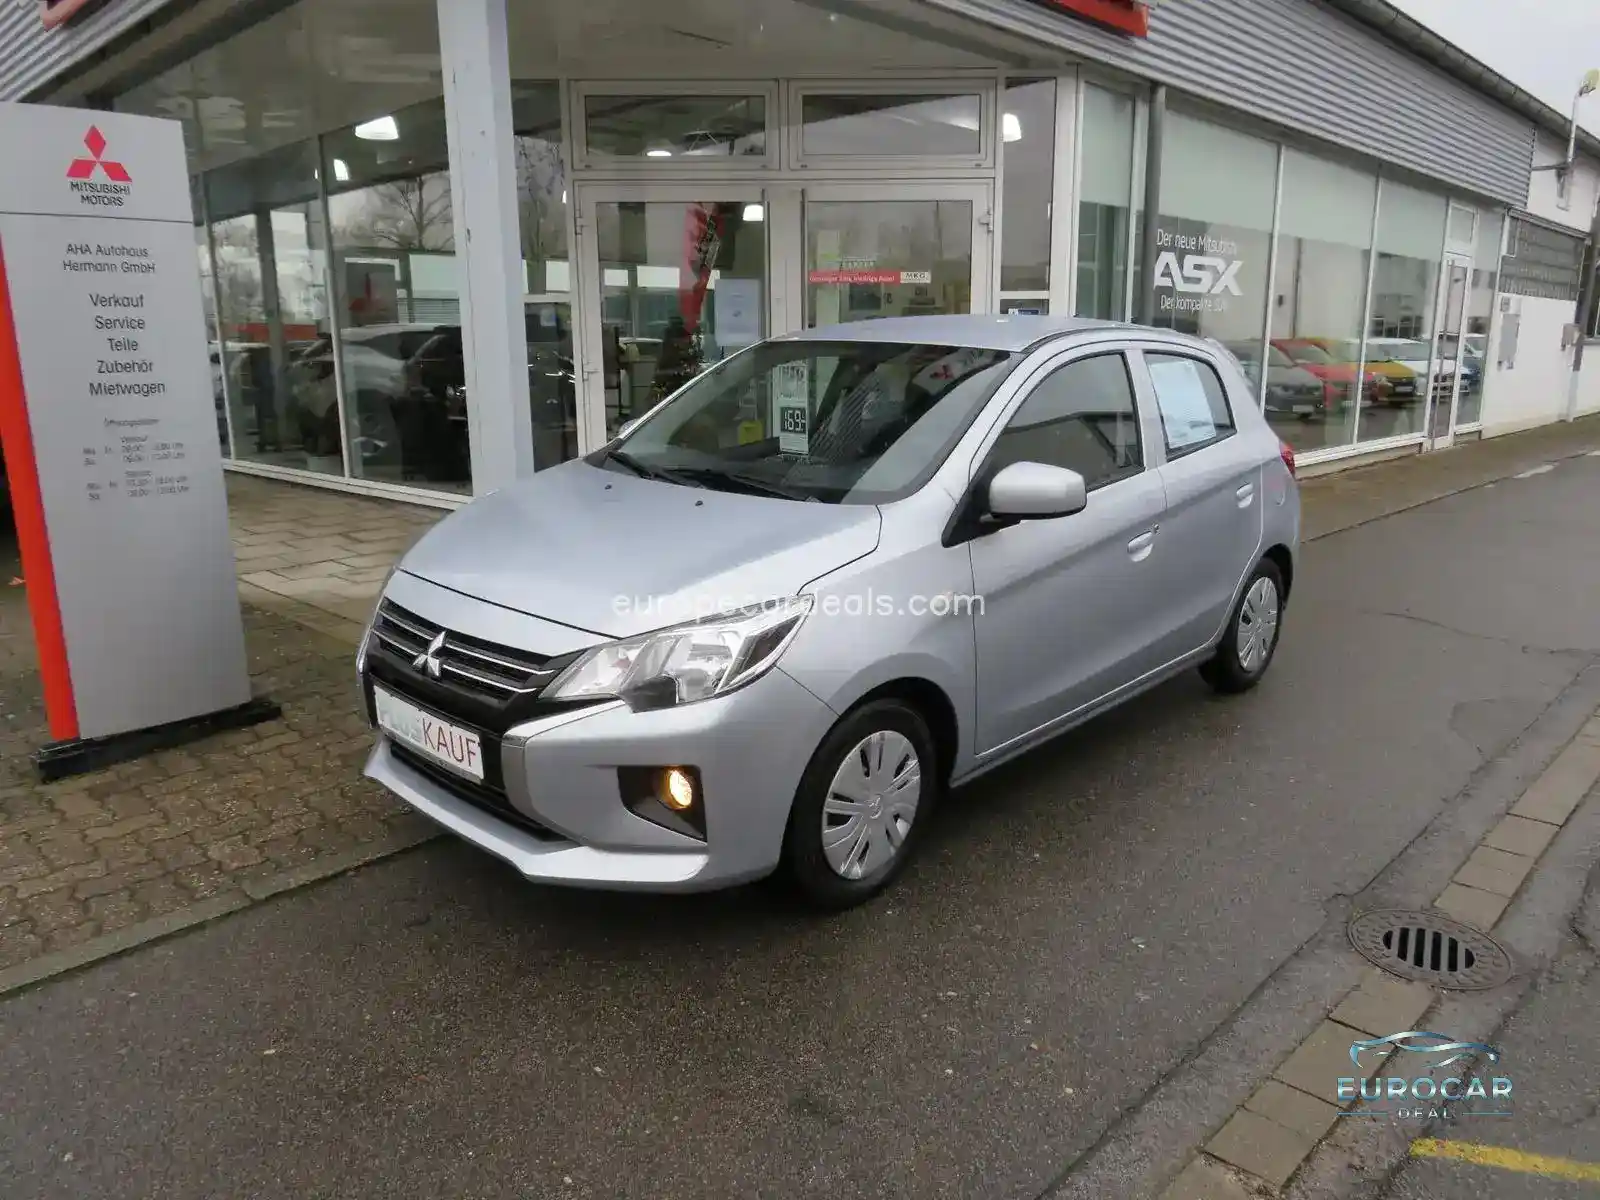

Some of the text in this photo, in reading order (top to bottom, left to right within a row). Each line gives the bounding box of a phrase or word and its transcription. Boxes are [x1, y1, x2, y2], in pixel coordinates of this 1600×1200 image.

[70, 181, 131, 195] MITSUBISHI
[80, 194, 124, 207] MOTORS
[1156, 228, 1173, 246] Der
[1174, 234, 1197, 250] neue
[66, 243, 149, 257] AHA Autohaus
[62, 260, 156, 274] Hermann GmbH
[1153, 251, 1244, 296] ASX
[88, 293, 144, 308] Verkauf
[94, 315, 146, 330] Service
[106, 337, 139, 352] Teile
[96, 359, 153, 374] Zubehör
[88, 381, 166, 397] Mietwagen
